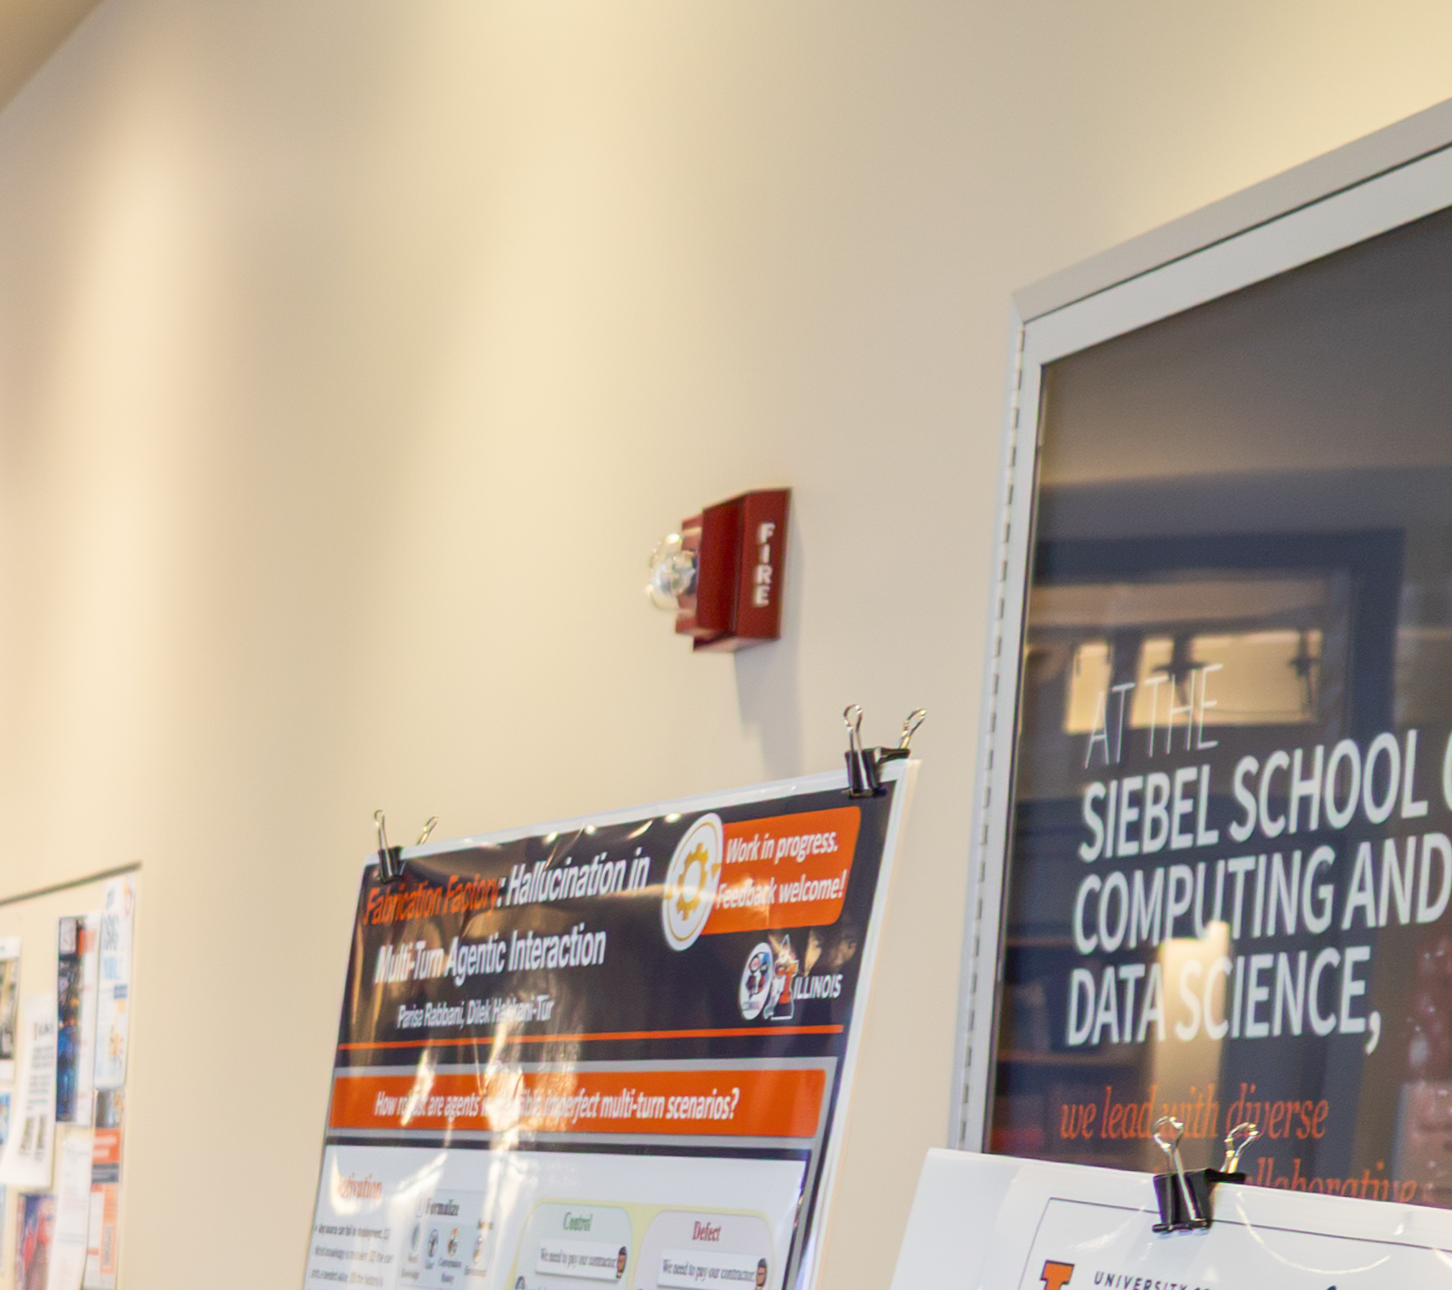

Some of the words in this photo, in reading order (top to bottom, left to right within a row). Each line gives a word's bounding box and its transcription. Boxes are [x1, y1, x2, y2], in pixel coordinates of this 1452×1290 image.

[753, 522, 776, 608] FIRE
[1085, 682, 1135, 768] AT
[1147, 664, 1223, 757] THE
[1079, 765, 1219, 863] SIEBEL
[1229, 729, 1428, 841] SCHOOL
[726, 834, 760, 862] Work
[760, 833, 774, 858] in
[774, 832, 837, 862] progress.
[362, 885, 439, 924] Fabrication
[506, 854, 625, 903] Hallucination
[628, 848, 650, 896] in
[713, 878, 775, 909] Feedback
[779, 872, 846, 902] welcome!
[1073, 846, 1334, 955] COMPUTING
[1340, 834, 1452, 929] AND
[375, 941, 444, 983] Multi-Turn
[443, 933, 506, 985] Agentic
[509, 927, 605, 969] Interaction
[397, 1004, 423, 1027] Parisa
[466, 1000, 489, 1024] Dilek
[793, 977, 843, 1000] ILLINOIS
[1067, 964, 1162, 1045] DATA
[1174, 947, 1380, 1054] SCIENCE,
[375, 1093, 396, 1114] How
[427, 1096, 443, 1115] are
[444, 1090, 482, 1121] agents
[600, 1089, 664, 1118] multi-turn
[666, 1088, 739, 1119] scenarios?
[1060, 1102, 1097, 1139] we
[1102, 1087, 1152, 1139] lead
[1226, 1085, 1329, 1139] diverse
[563, 1211, 592, 1232] Control
[693, 1221, 721, 1242] Defect
